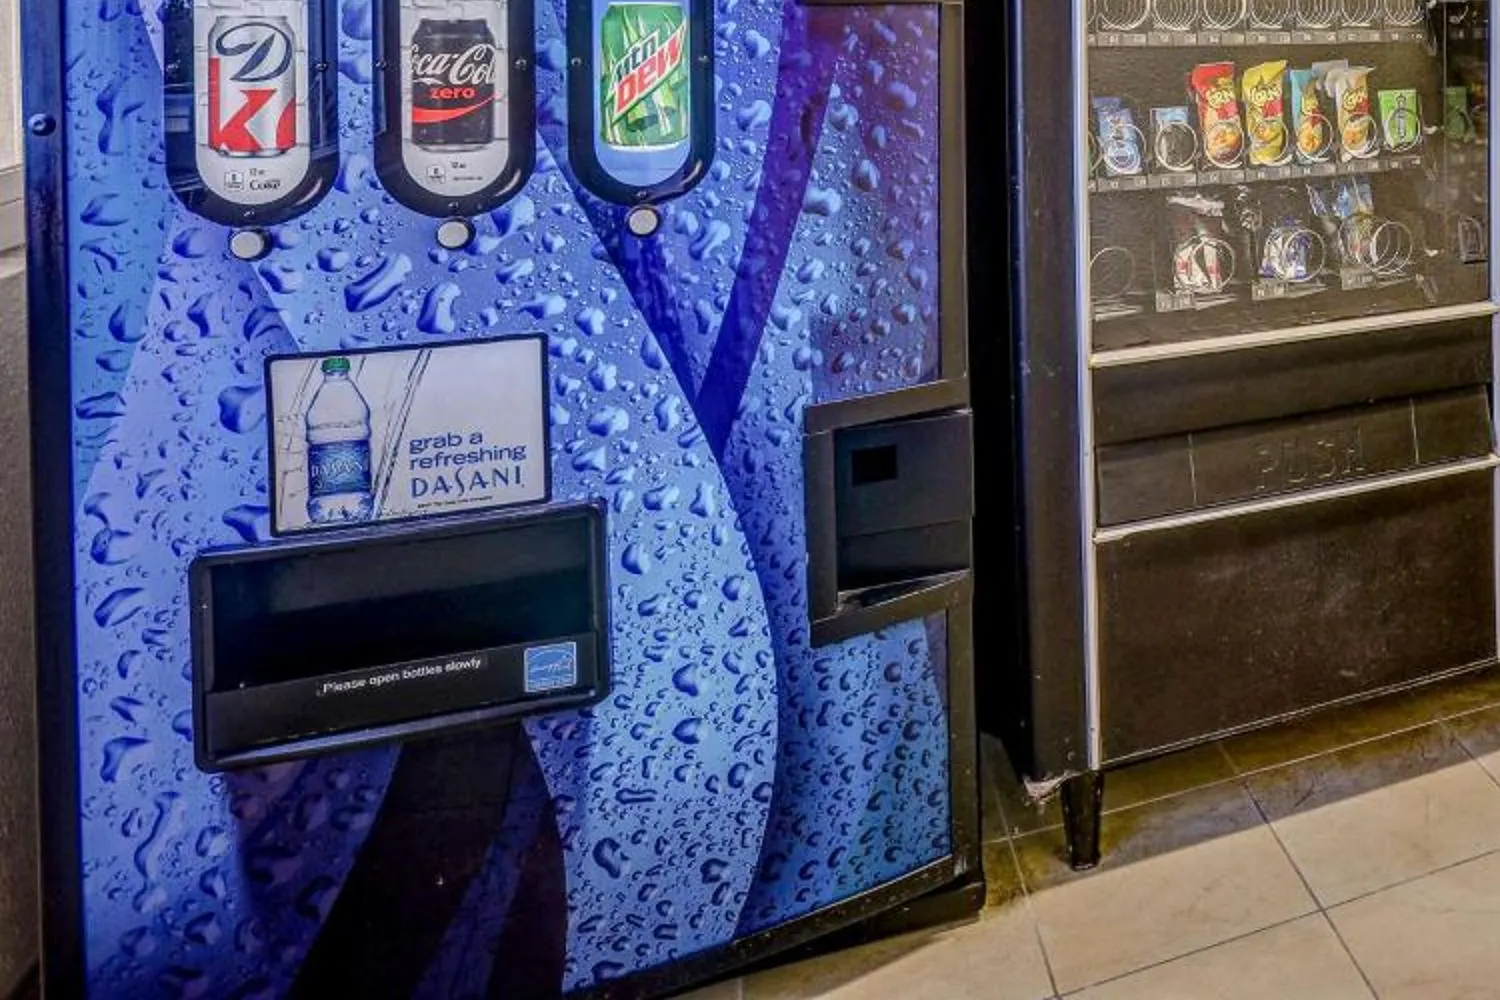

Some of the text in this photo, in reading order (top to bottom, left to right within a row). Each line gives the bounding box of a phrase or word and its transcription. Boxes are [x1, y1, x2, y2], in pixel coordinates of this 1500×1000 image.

[615, 24, 684, 115] DEW
[430, 86, 475, 99] zero
[409, 432, 483, 455] grab a
[409, 445, 528, 471] refreshing
[411, 465, 522, 499] DASANI
[322, 656, 482, 693] Please open bottles slowly
